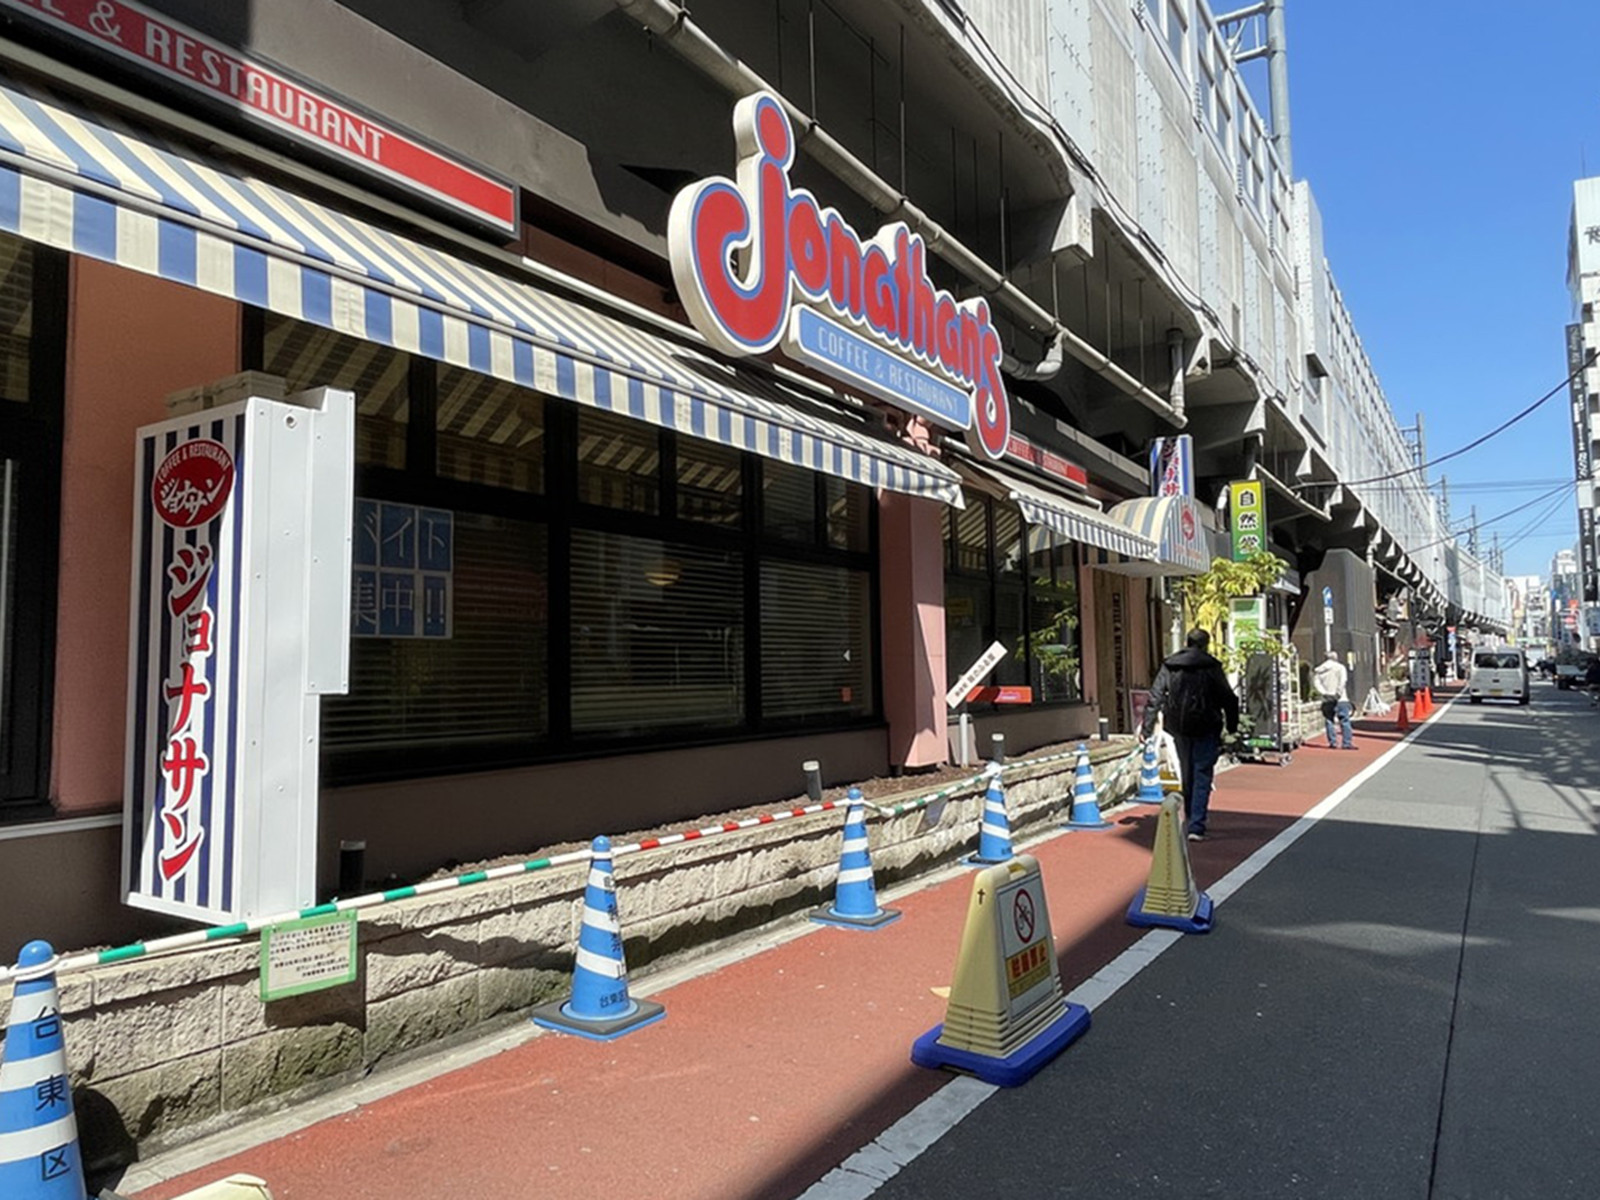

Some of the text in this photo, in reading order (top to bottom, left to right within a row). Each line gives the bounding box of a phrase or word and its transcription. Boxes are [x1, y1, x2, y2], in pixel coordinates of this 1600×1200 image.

[145, 21, 385, 162] RESTAURANT
[817, 325, 870, 373] COFFEE
[888, 363, 960, 417] RESTAURANT
[161, 545, 211, 881] ジョナサン
[32, 1005, 71, 1181] 台東区
